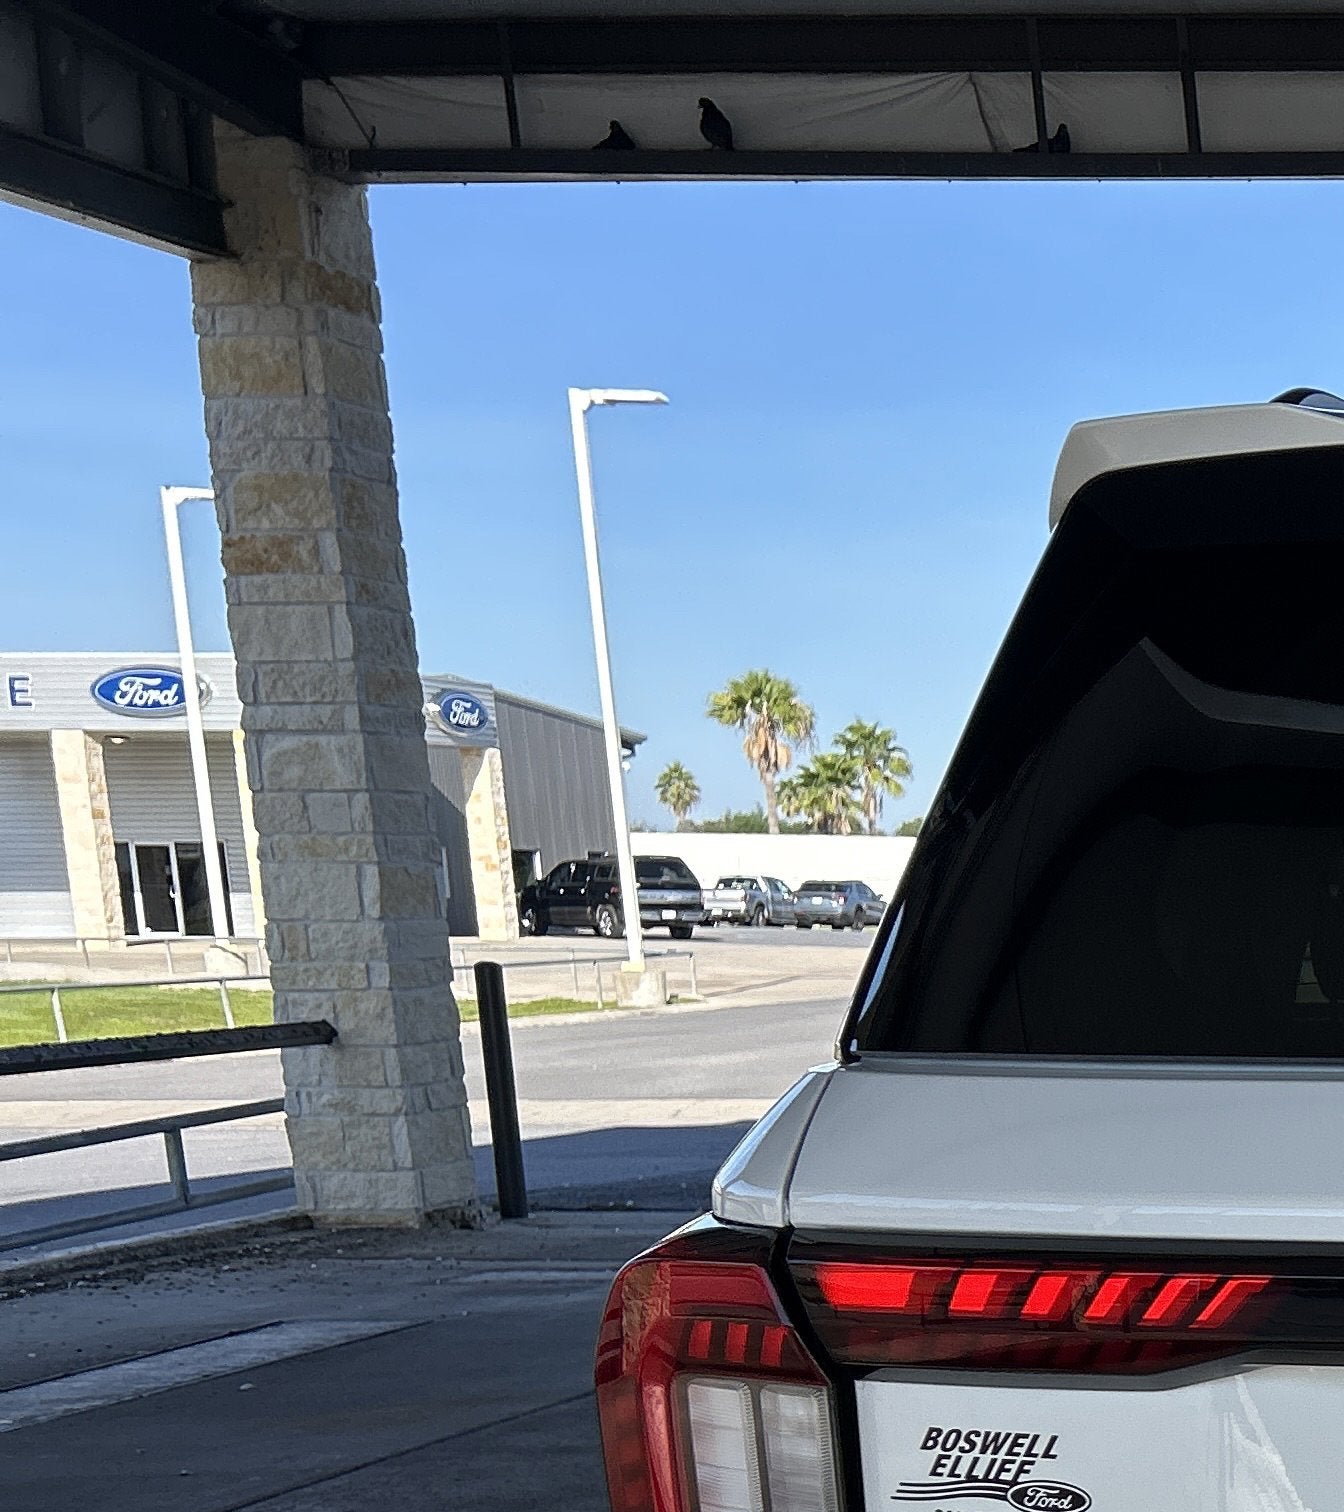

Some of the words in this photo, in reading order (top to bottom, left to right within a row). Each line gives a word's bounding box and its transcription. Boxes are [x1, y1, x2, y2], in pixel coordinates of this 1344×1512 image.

[114, 676, 179, 707] Ford
[449, 699, 480, 726] Ford
[920, 1426, 1059, 1460] BOSWELL
[929, 1454, 1036, 1484] ELLIFF
[1023, 1486, 1073, 1510] Ford
